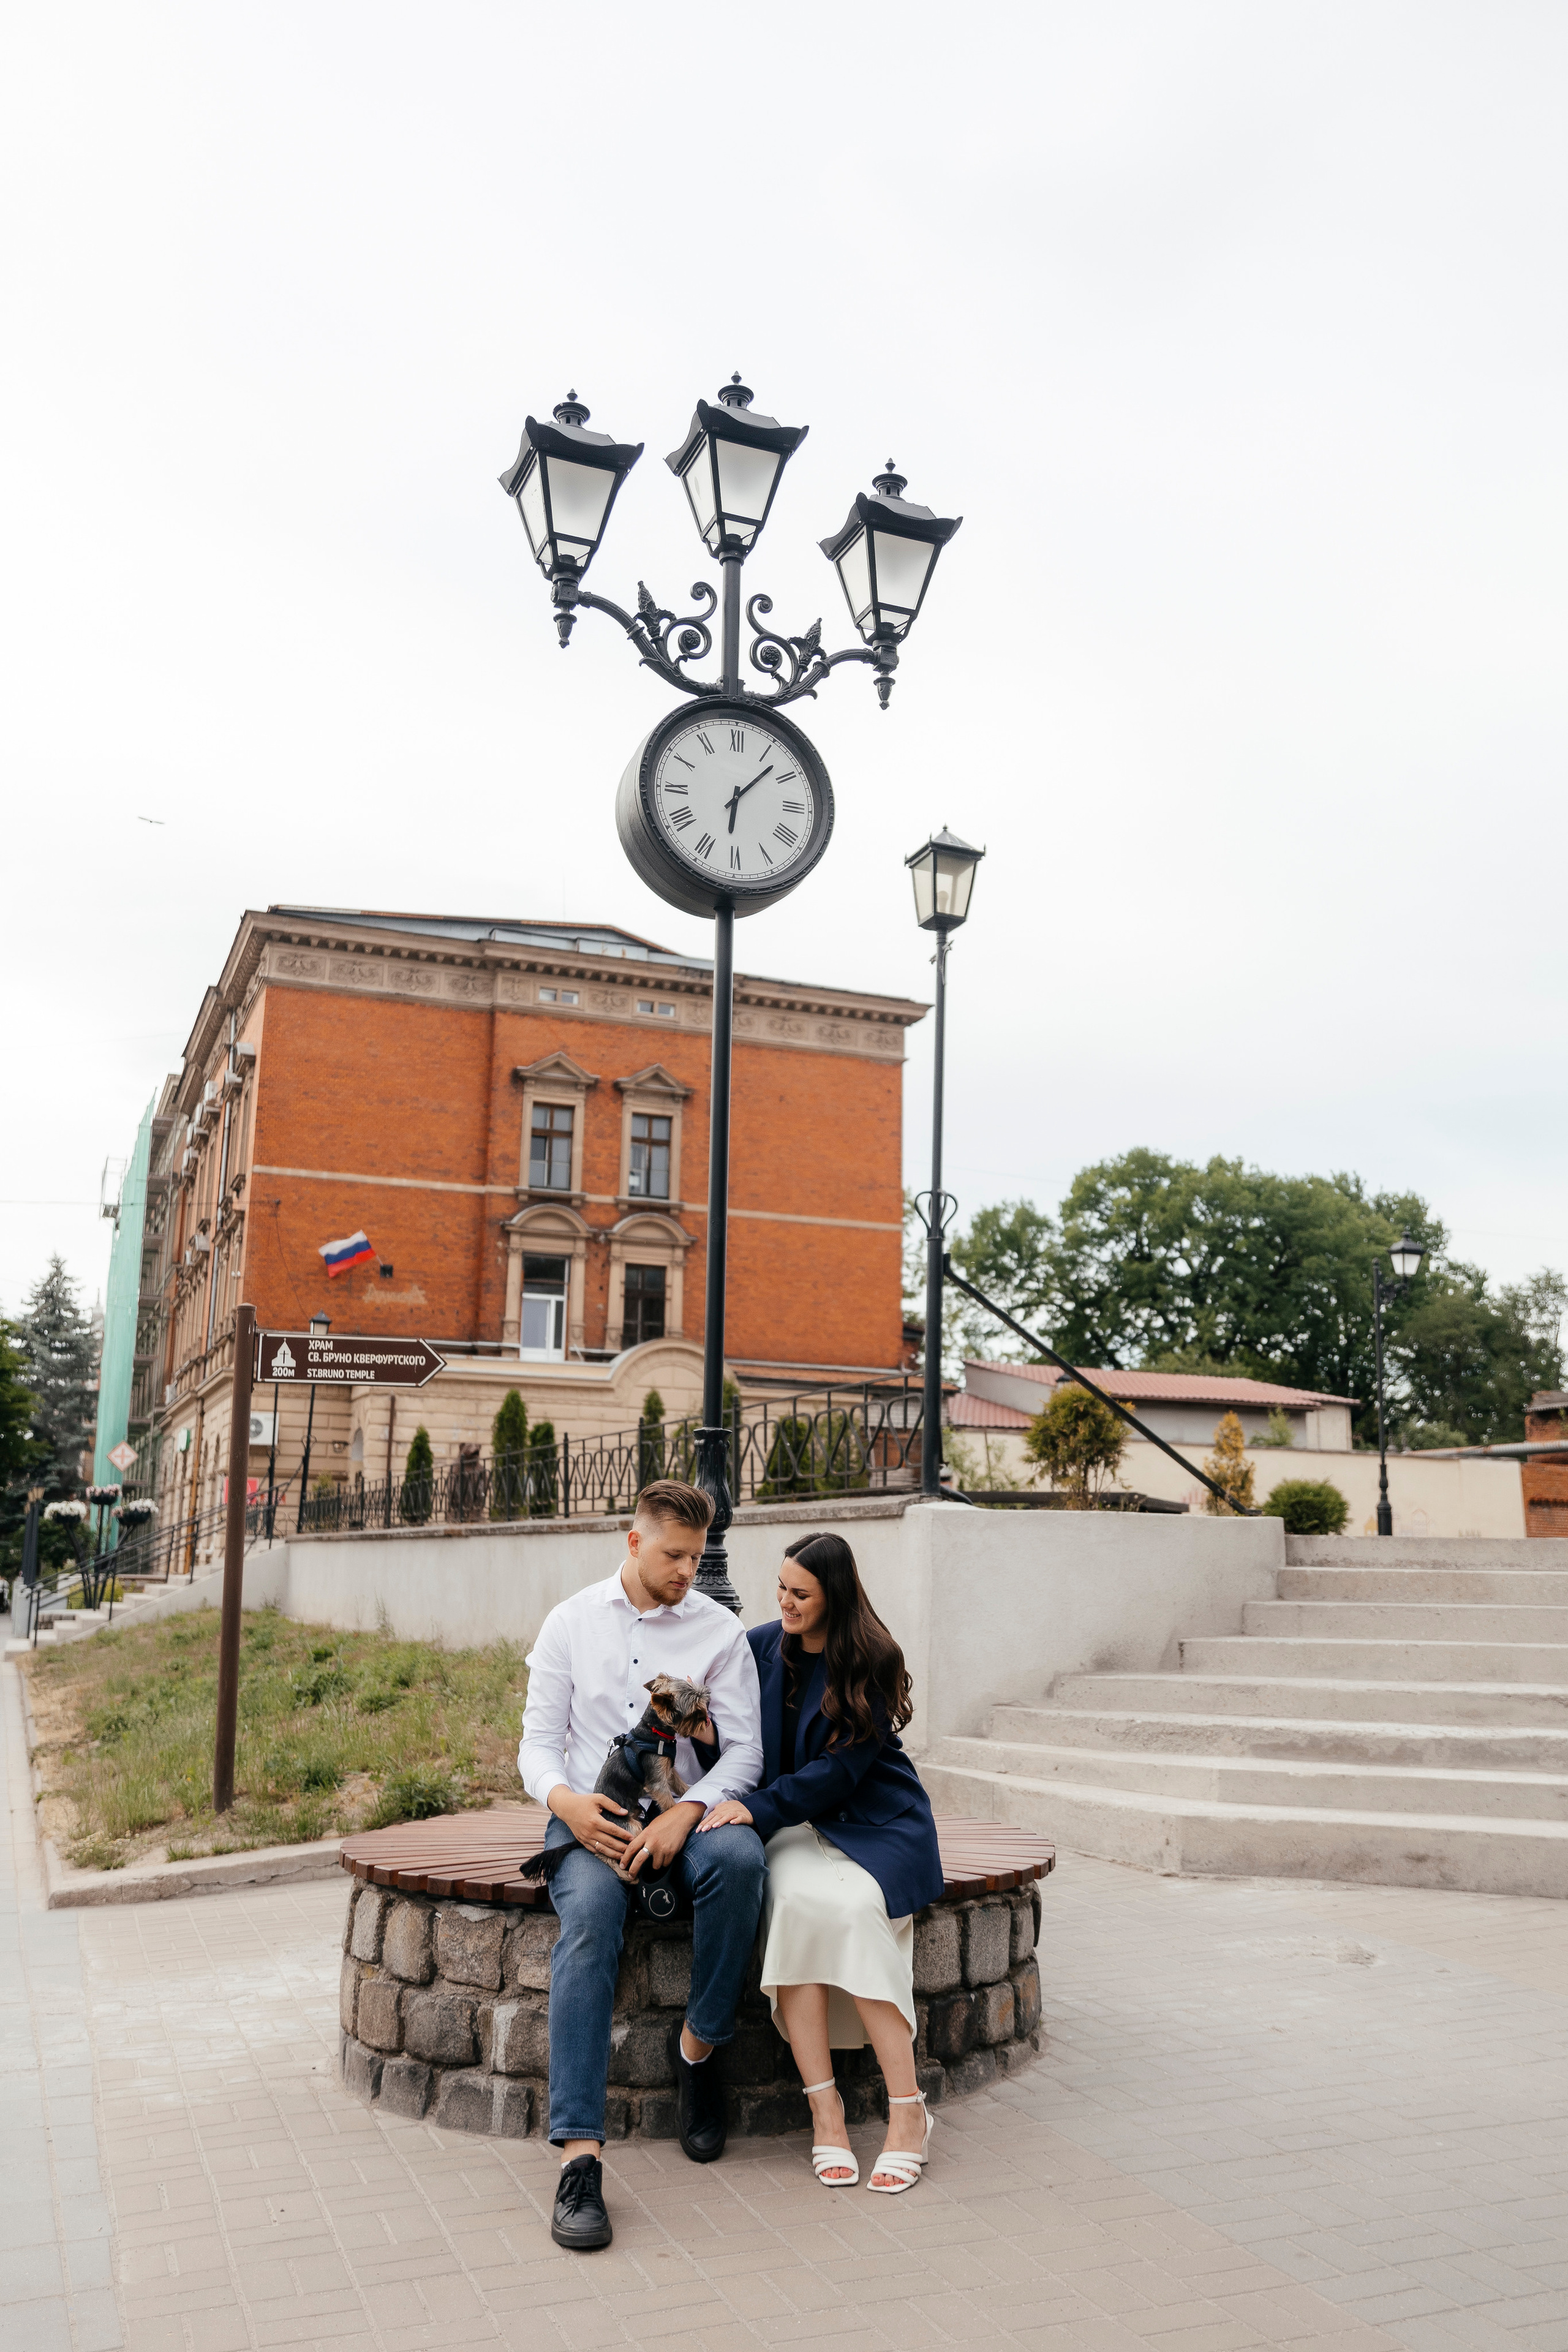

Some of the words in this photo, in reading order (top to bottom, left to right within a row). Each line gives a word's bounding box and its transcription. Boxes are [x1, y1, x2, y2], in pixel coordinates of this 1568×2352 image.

[696, 732, 715, 756] XI
[729, 729, 744, 753] XII
[673, 752, 696, 772] X
[665, 781, 688, 795] IX
[775, 771, 797, 784] II
[669, 805, 697, 832] VIII
[782, 800, 805, 815] III
[694, 832, 717, 859] VII
[772, 822, 799, 848] IIII
[730, 845, 741, 870] VI
[758, 842, 774, 867] V
[308, 1340, 333, 1351] ХРАМ
[307, 1352, 322, 1362] СВ.
[323, 1352, 352, 1363] БРУНО
[353, 1353, 426, 1366] КВЕРФУРТСКОГО
[345, 1370, 375, 1379] TEMPLE
